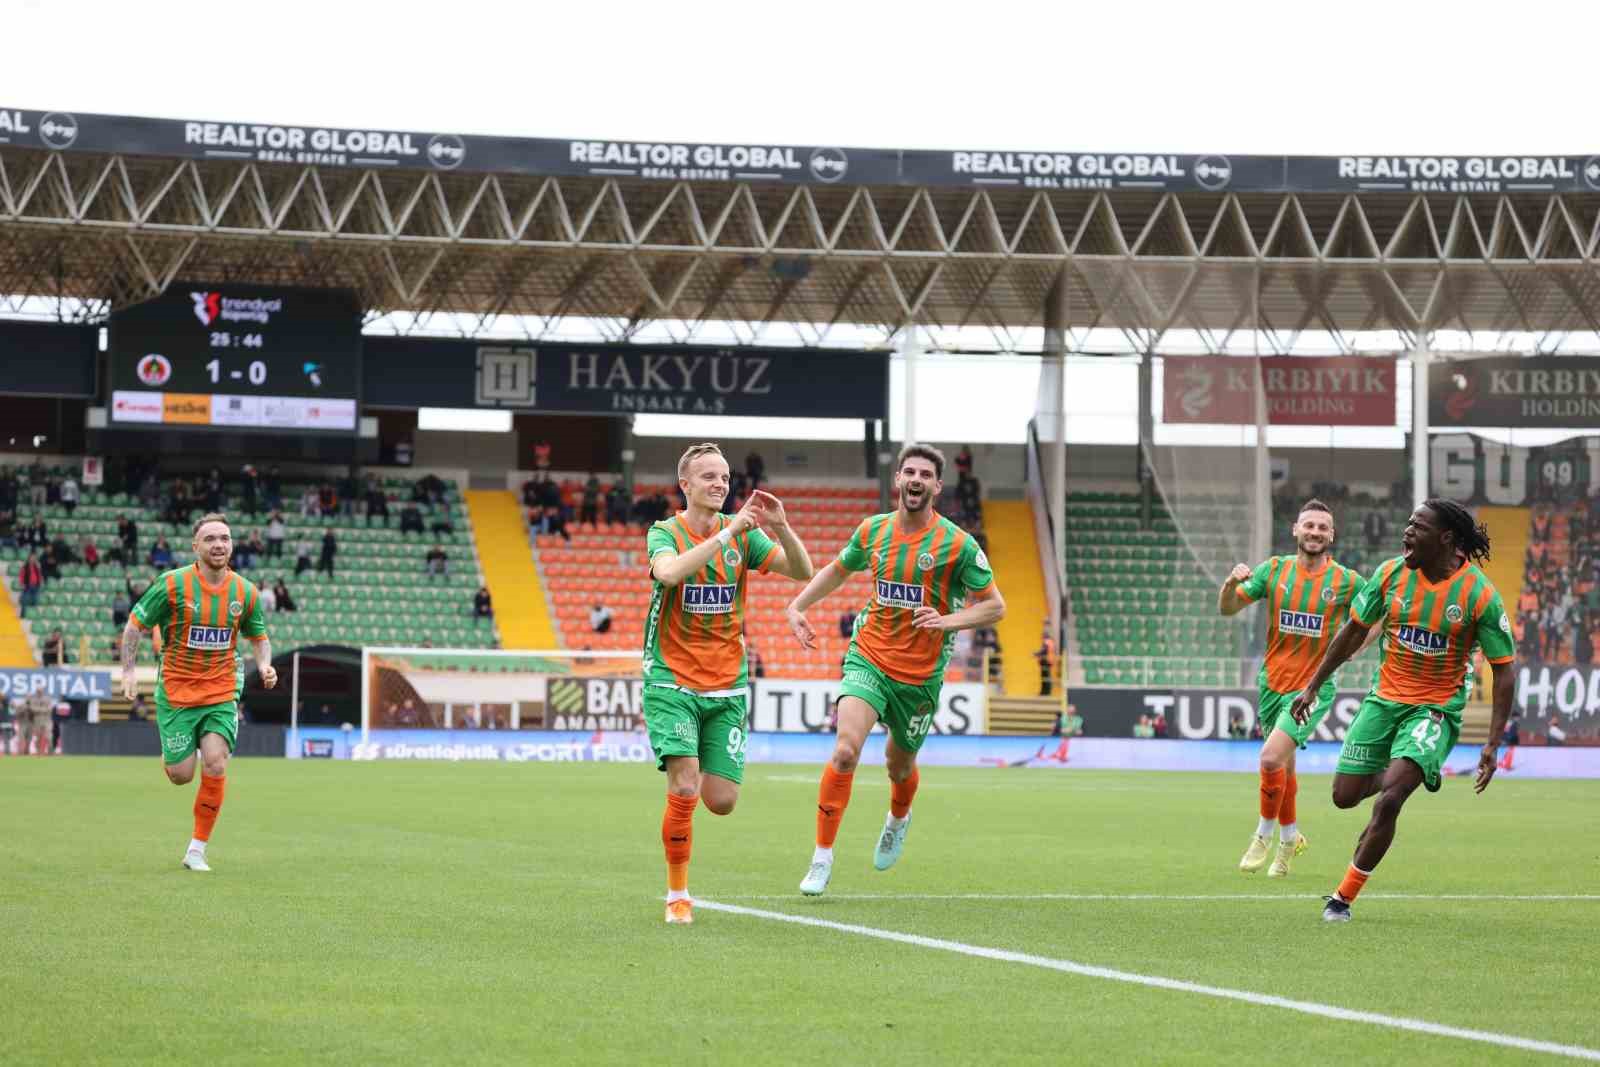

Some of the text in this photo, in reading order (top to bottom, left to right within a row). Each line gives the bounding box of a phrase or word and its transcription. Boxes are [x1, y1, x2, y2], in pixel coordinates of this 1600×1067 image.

[184, 122, 419, 154] REALTOR GLOBAL
[258, 150, 347, 165] REAL ESTATE
[569, 142, 801, 168] REALTOR GLOBAL
[953, 152, 1185, 176] REALTOR GLOBAL
[642, 168, 730, 179] REAL ESTATE
[1339, 158, 1574, 178] REALTOR GLOBAL
[1024, 177, 1113, 188] REAL ESTATE
[1411, 180, 1500, 192] REAL ESTATE
[206, 359, 220, 383] 1
[249, 360, 267, 385] 0
[568, 351, 771, 393] HAKYÜZ
[688, 588, 733, 602] TAV
[879, 582, 920, 599] TAV
[1283, 613, 1320, 628] TAV
[192, 629, 230, 641] TAV
[906, 713, 931, 736] 50
[1411, 719, 1441, 752] 42
